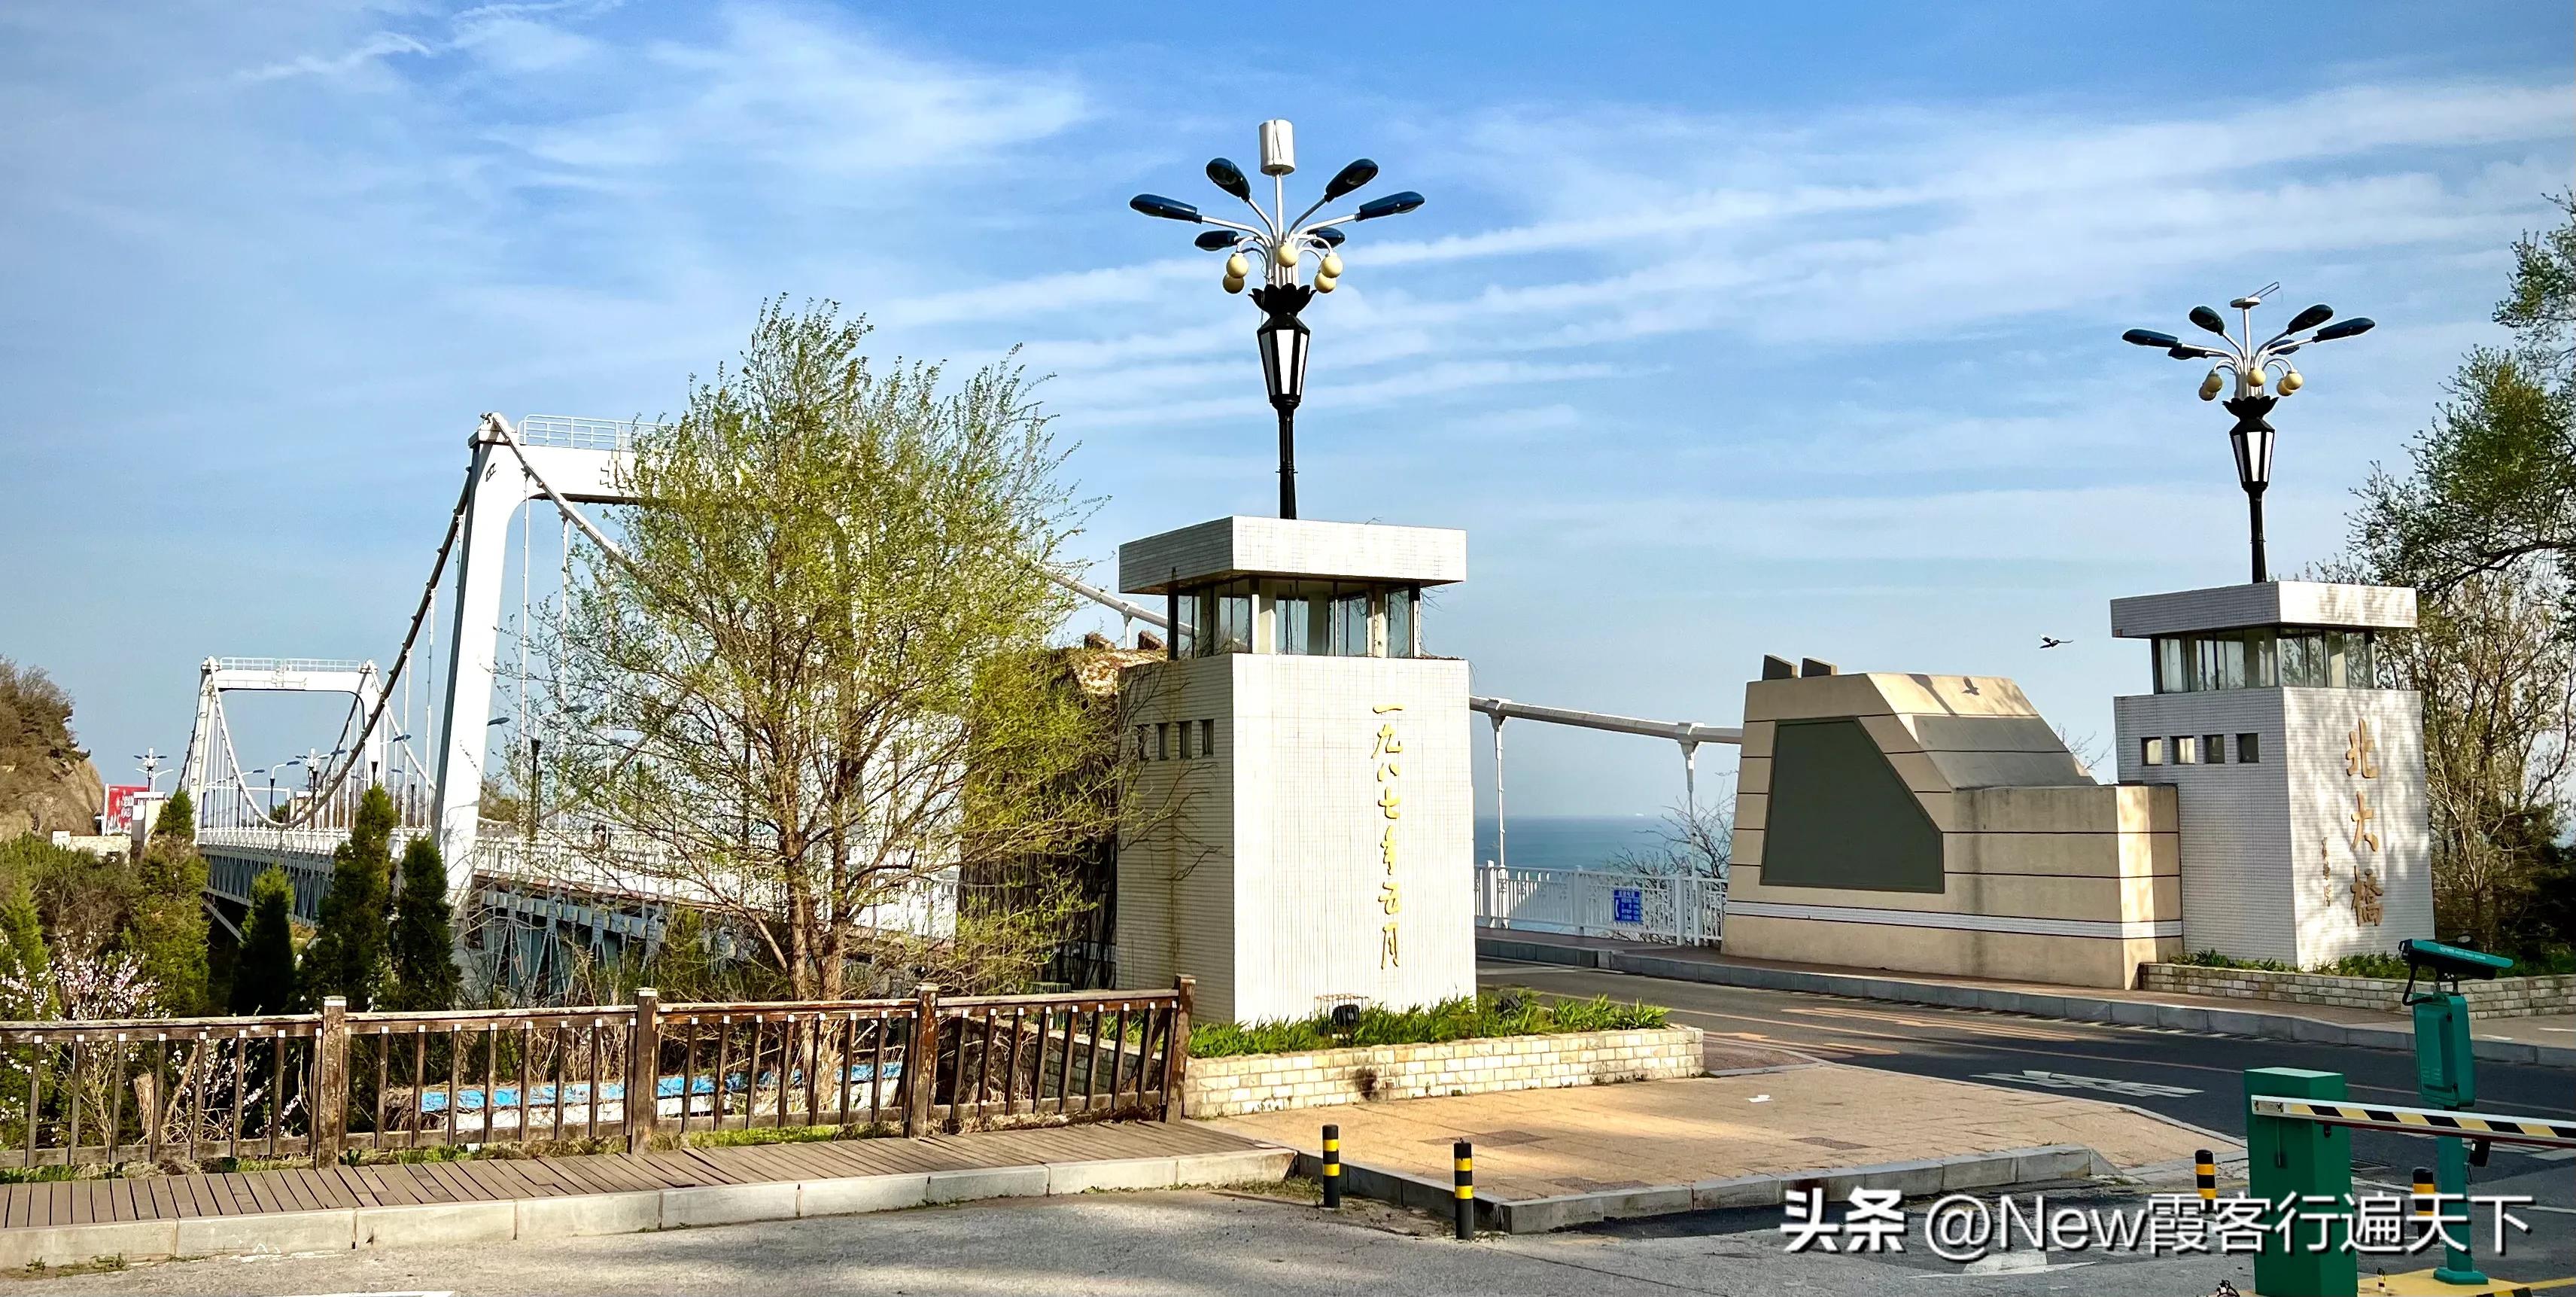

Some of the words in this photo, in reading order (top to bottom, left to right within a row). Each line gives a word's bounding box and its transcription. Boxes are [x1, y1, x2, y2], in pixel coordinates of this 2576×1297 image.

[1370, 703, 1404, 970] 一九八七年五月
